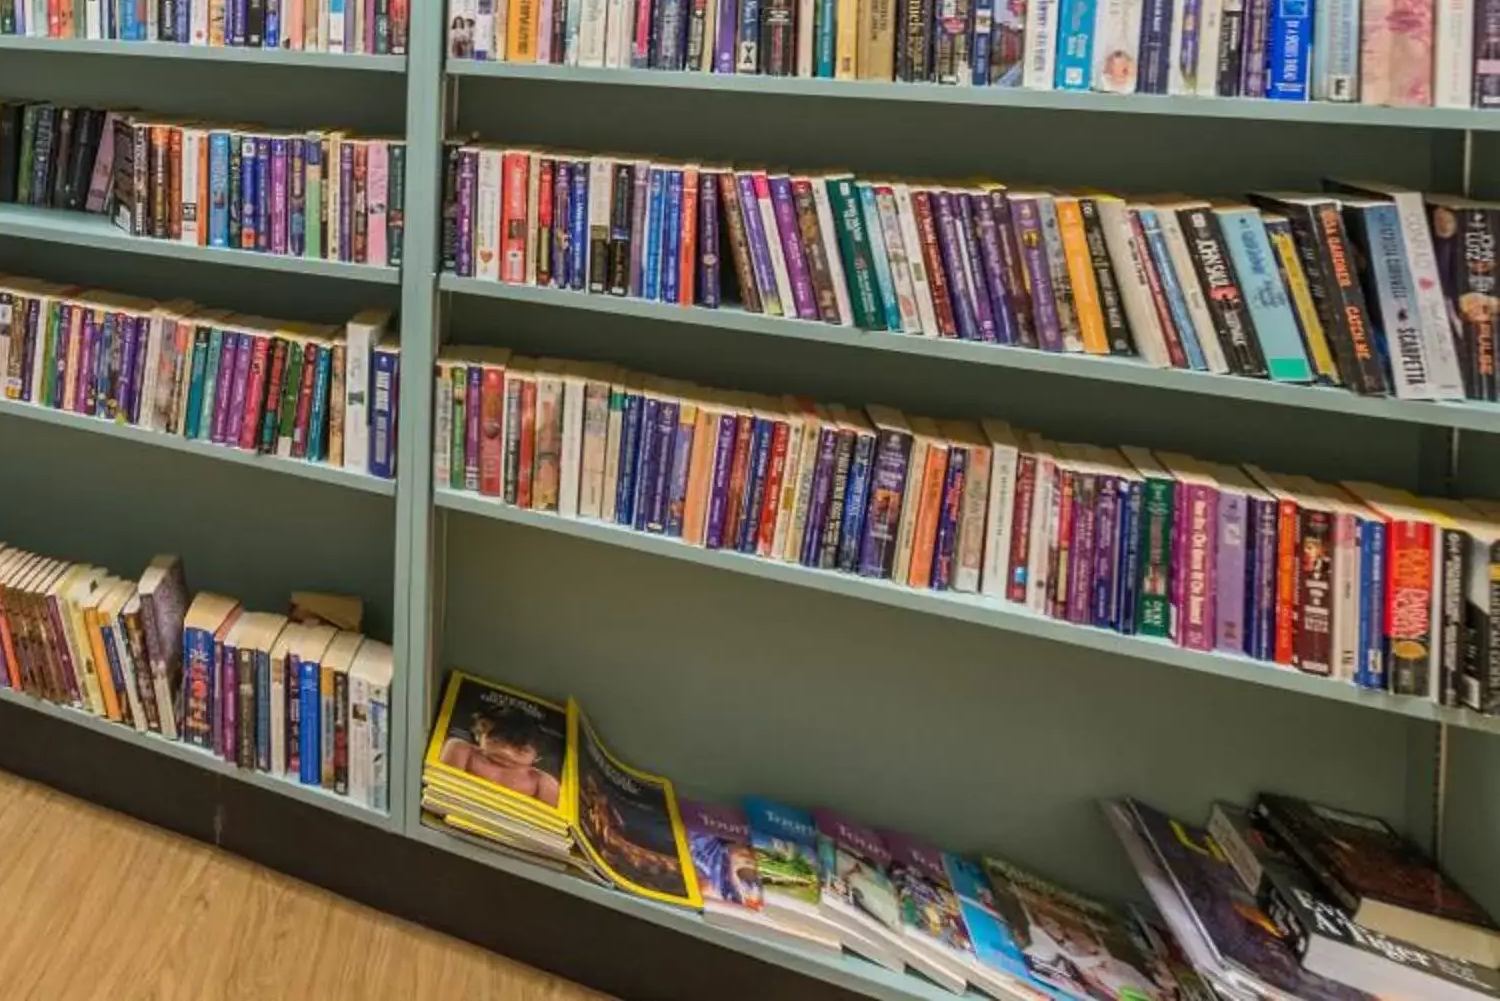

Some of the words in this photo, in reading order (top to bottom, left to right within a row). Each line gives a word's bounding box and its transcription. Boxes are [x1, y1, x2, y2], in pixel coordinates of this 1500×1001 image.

[1195, 239, 1221, 266] JOHN
[1327, 236, 1351, 288] GARDNER
[1466, 231, 1481, 261] LUTZ
[1396, 327, 1427, 386] SCARPETTA
